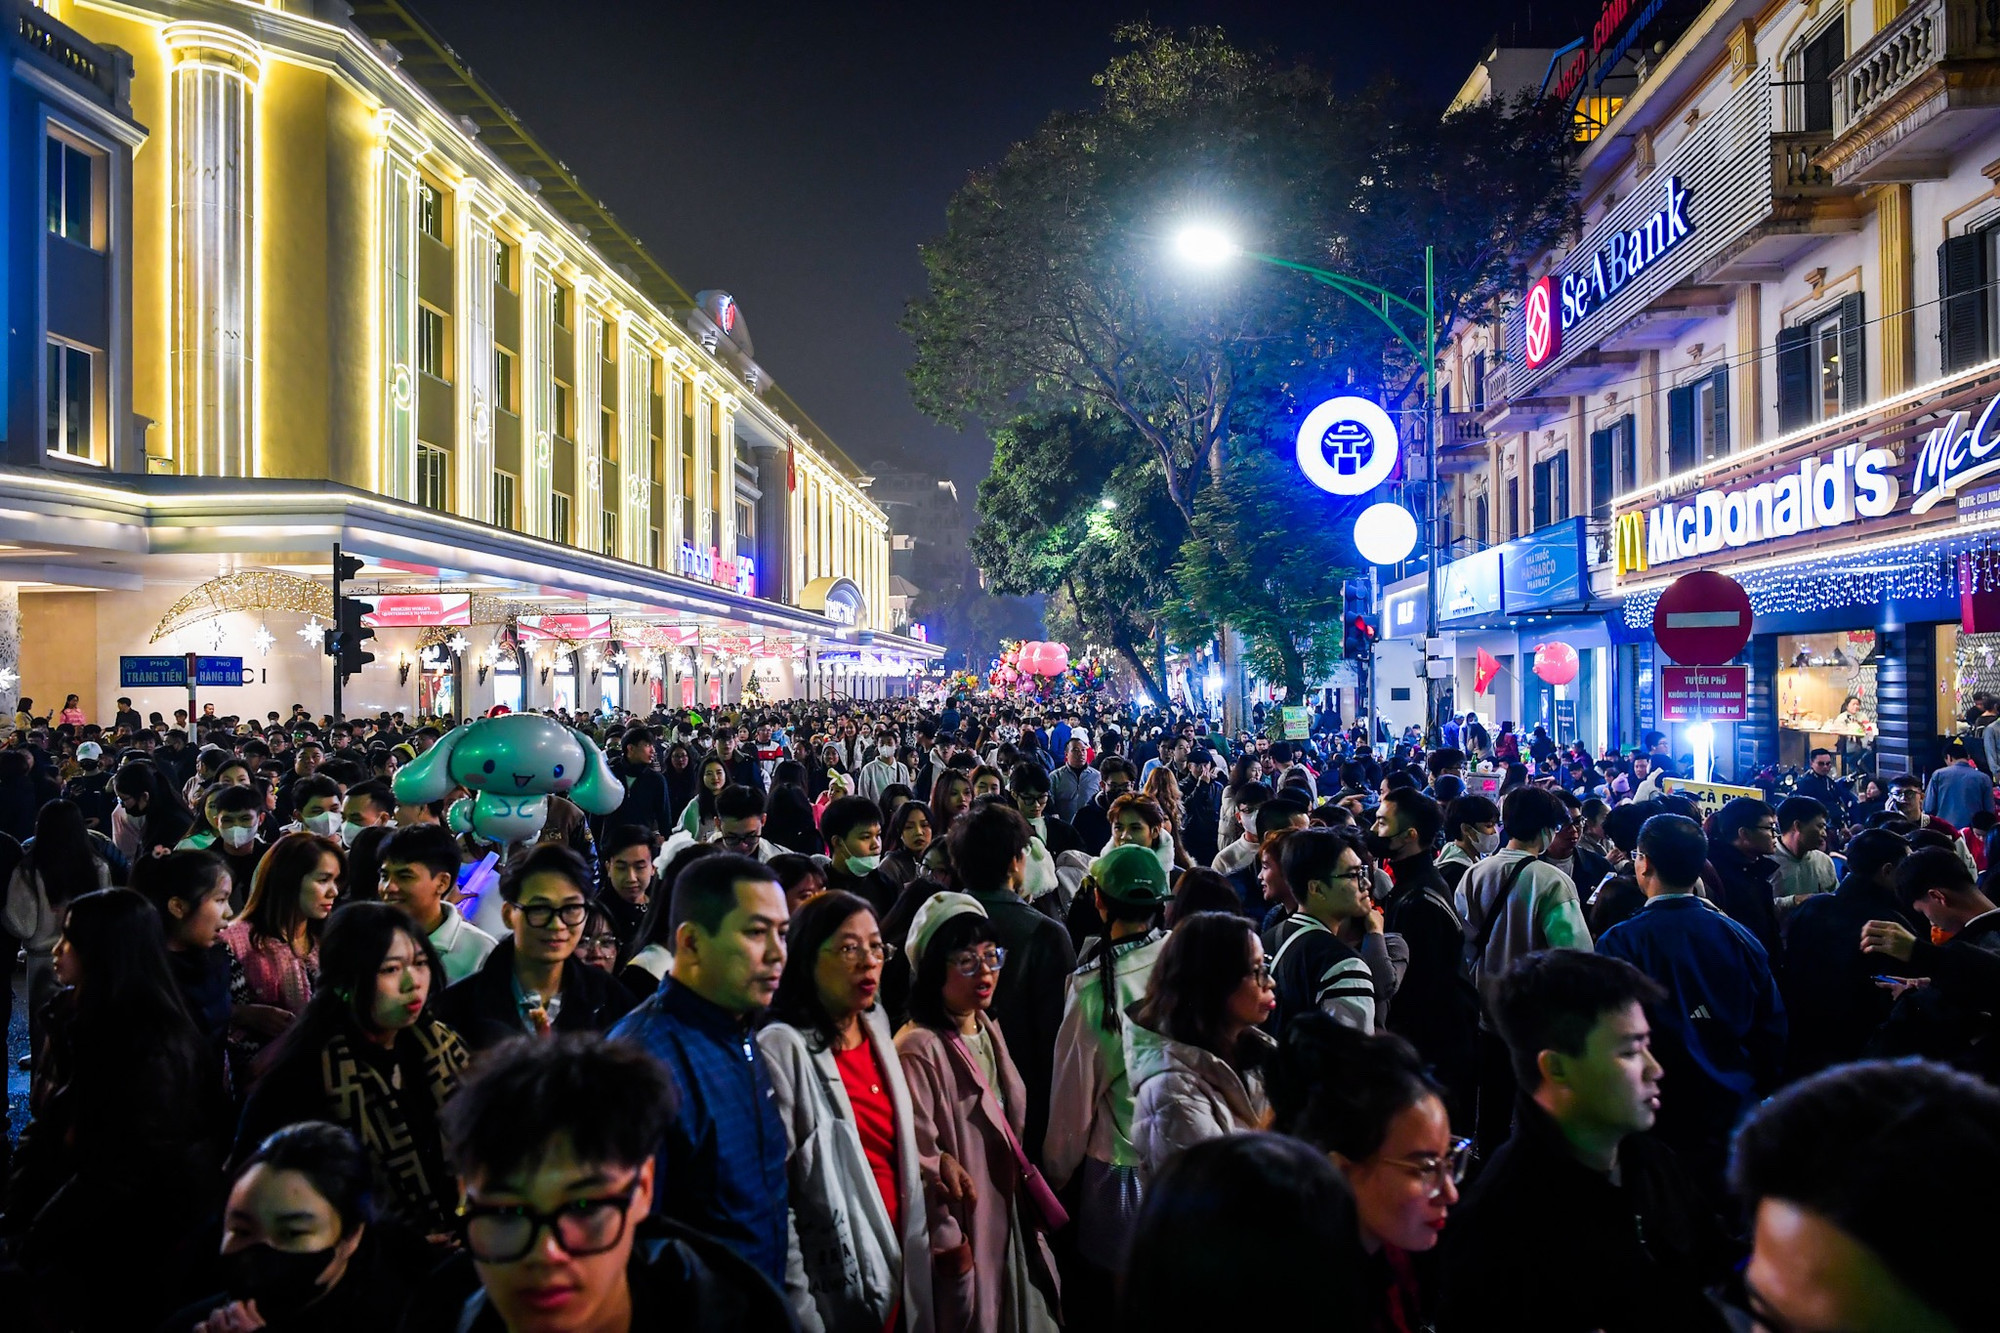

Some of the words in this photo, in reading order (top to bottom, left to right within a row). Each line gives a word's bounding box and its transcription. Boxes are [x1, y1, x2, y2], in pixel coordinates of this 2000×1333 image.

[1562, 177, 1691, 330] SeABank
[1648, 443, 1899, 566] McDonald's
[736, 554, 755, 597] 5G
[1527, 576, 1550, 590] PHARMACY
[126, 669, 159, 682] TRÀNG
[161, 668, 182, 682] TIỀN
[200, 669, 226, 682] HÀNG
[226, 669, 240, 682] BÀI
[1684, 674, 1709, 685] TUYẾN
[1711, 674, 1727, 685] PHỐ
[1668, 690, 1688, 699] KHÔNG
[1706, 691, 1720, 699] KINH
[1722, 691, 1741, 699] DOANH
[1671, 705, 1687, 714] BUÔN
[1698, 789, 1716, 803] CÀ
